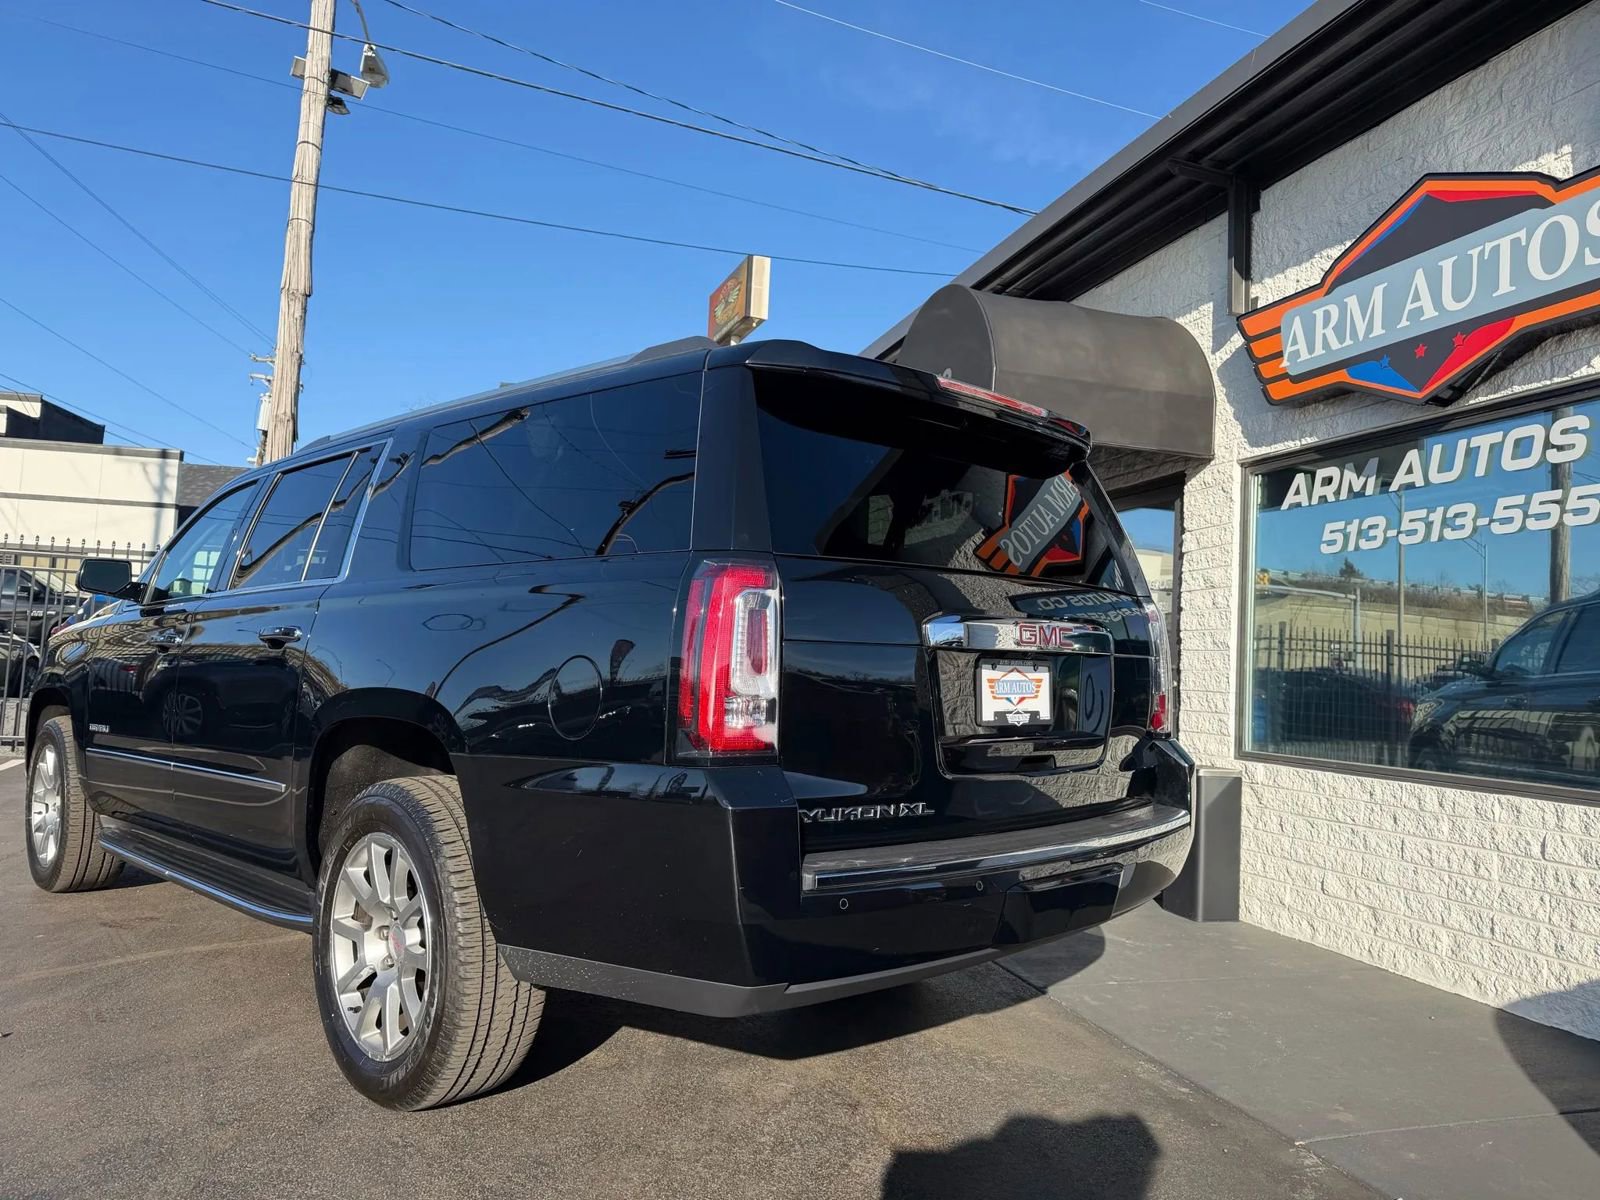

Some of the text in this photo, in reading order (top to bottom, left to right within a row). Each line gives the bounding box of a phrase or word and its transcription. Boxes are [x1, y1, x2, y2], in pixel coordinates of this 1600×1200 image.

[1278, 282, 1388, 368] ARM
[1280, 414, 1591, 511] ARM AUTOS
[1319, 483, 1600, 554] 513-513-555
[1018, 623, 1075, 649] GMC
[995, 681, 1036, 694] ARM AUTOS
[798, 802, 936, 823] YUKON XL
